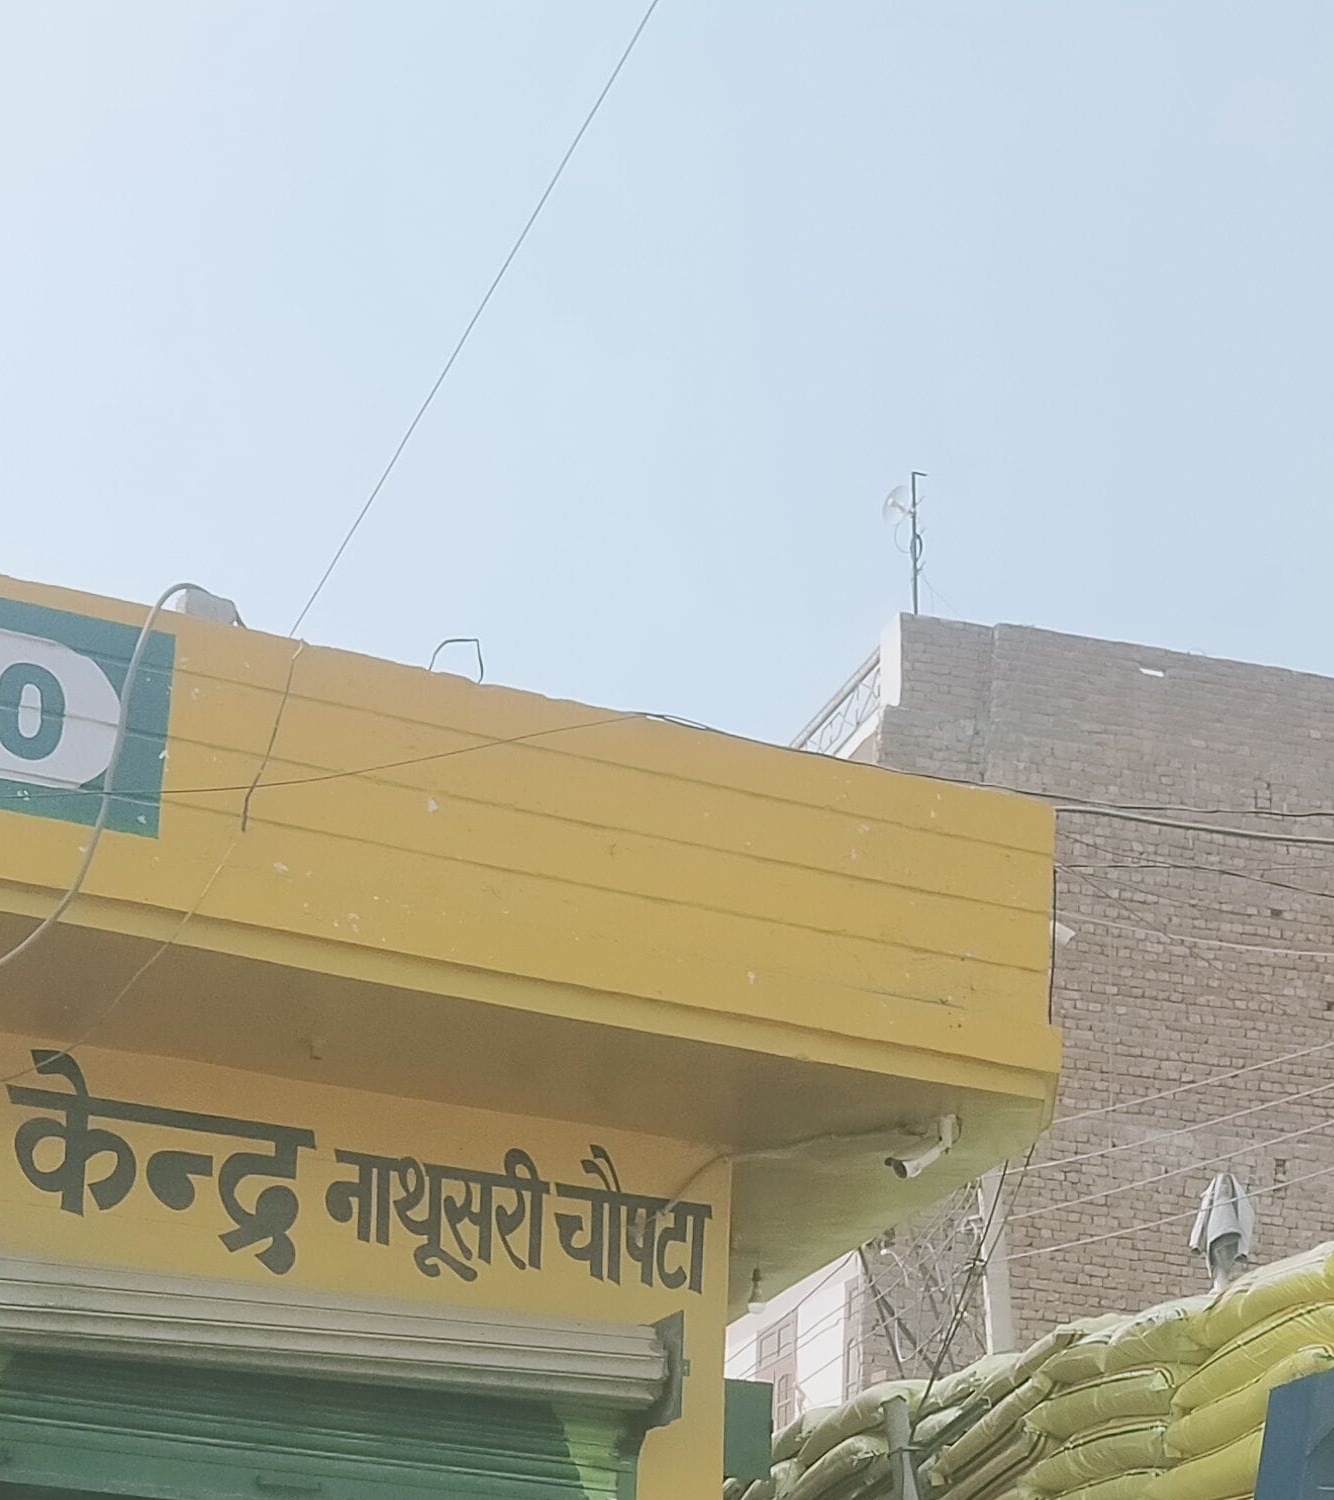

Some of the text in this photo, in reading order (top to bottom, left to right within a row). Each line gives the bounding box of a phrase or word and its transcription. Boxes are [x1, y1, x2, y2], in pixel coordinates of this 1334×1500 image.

[6, 1049, 316, 1275] केन्द्र
[325, 1147, 551, 1282] नाथूसरी
[554, 1144, 713, 1295] चौपटा
